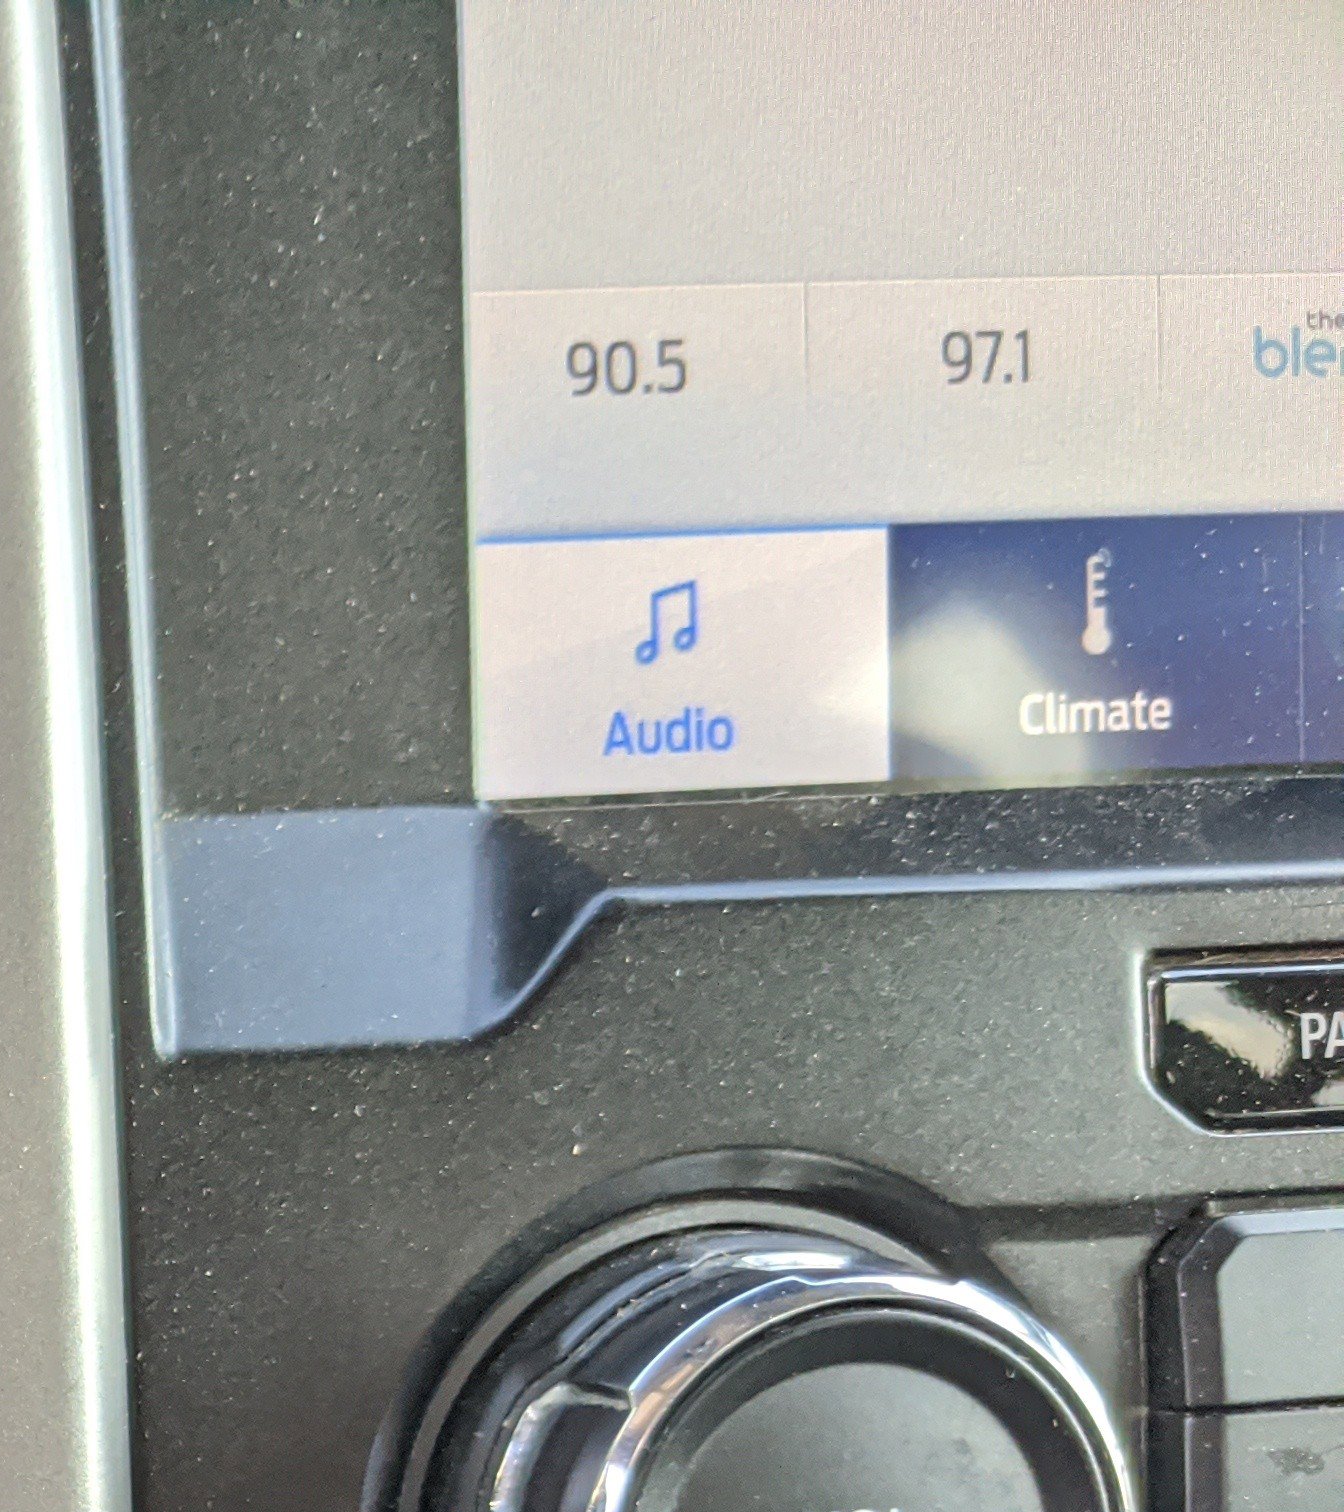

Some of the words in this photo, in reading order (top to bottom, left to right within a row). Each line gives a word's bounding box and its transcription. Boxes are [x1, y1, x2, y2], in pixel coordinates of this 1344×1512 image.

[566, 339, 688, 396] 90.5
[941, 329, 1031, 385] 97.1
[1254, 325, 1344, 378] ble
[603, 707, 734, 757] Audio
[1018, 690, 1173, 737] Climate
